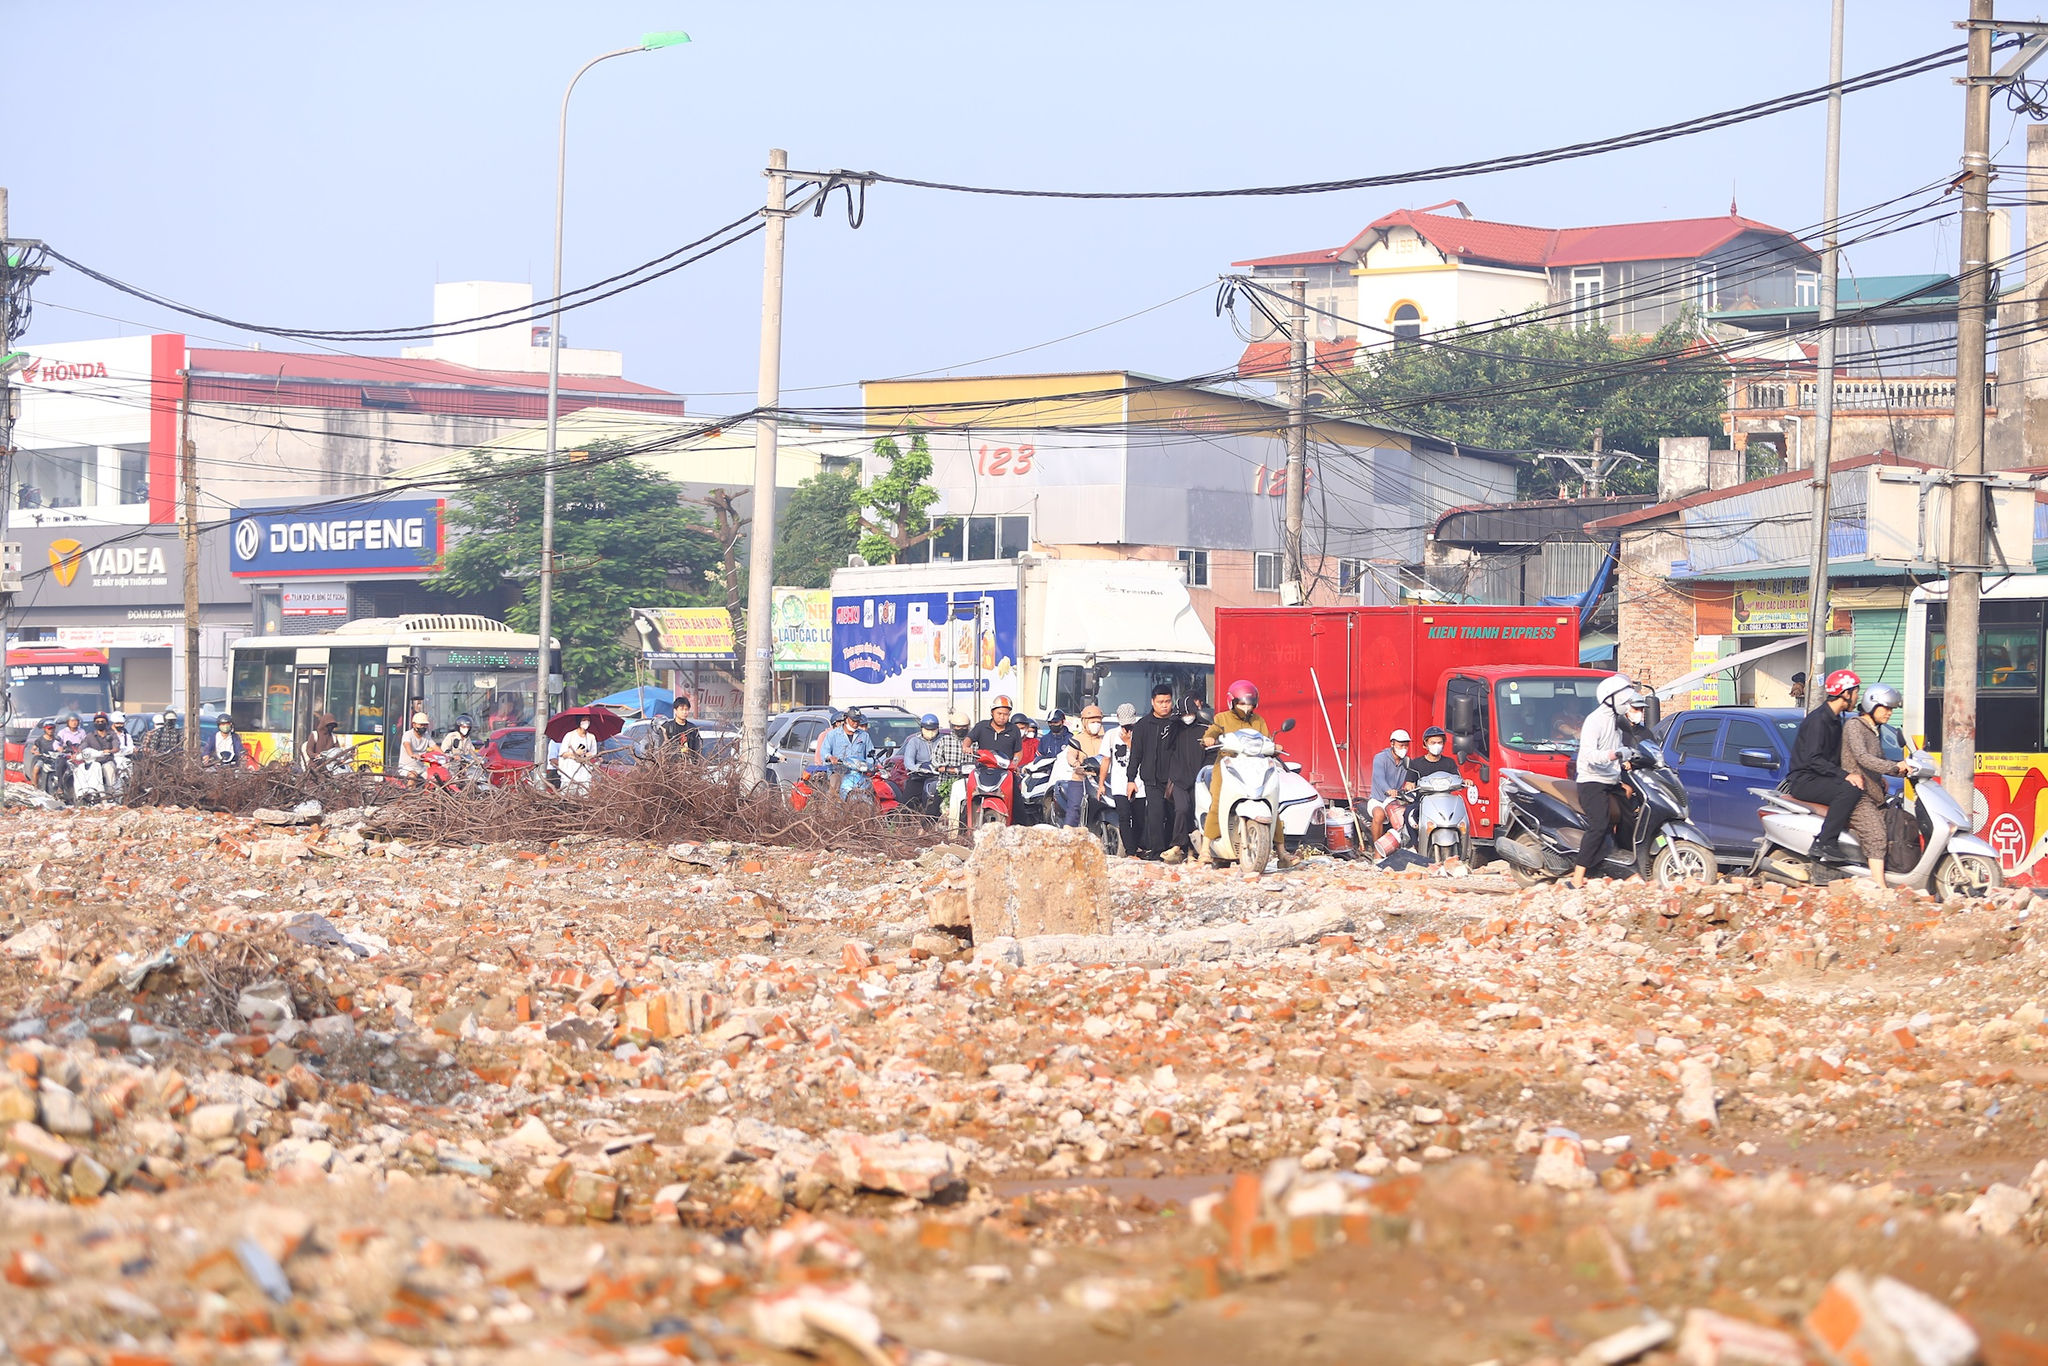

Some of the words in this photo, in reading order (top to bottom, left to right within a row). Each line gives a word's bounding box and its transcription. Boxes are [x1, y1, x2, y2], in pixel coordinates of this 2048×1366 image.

[42, 362, 108, 382] HONDA
[978, 443, 1035, 476] 123
[270, 518, 425, 553] DONGFENG
[86, 548, 167, 576] YADEA
[149, 610, 163, 619] GIA
[807, 603, 828, 620] NH
[1428, 626, 1458, 639] KIEN
[1460, 626, 1500, 639] THANH
[1501, 626, 1556, 640] EXPRESS
